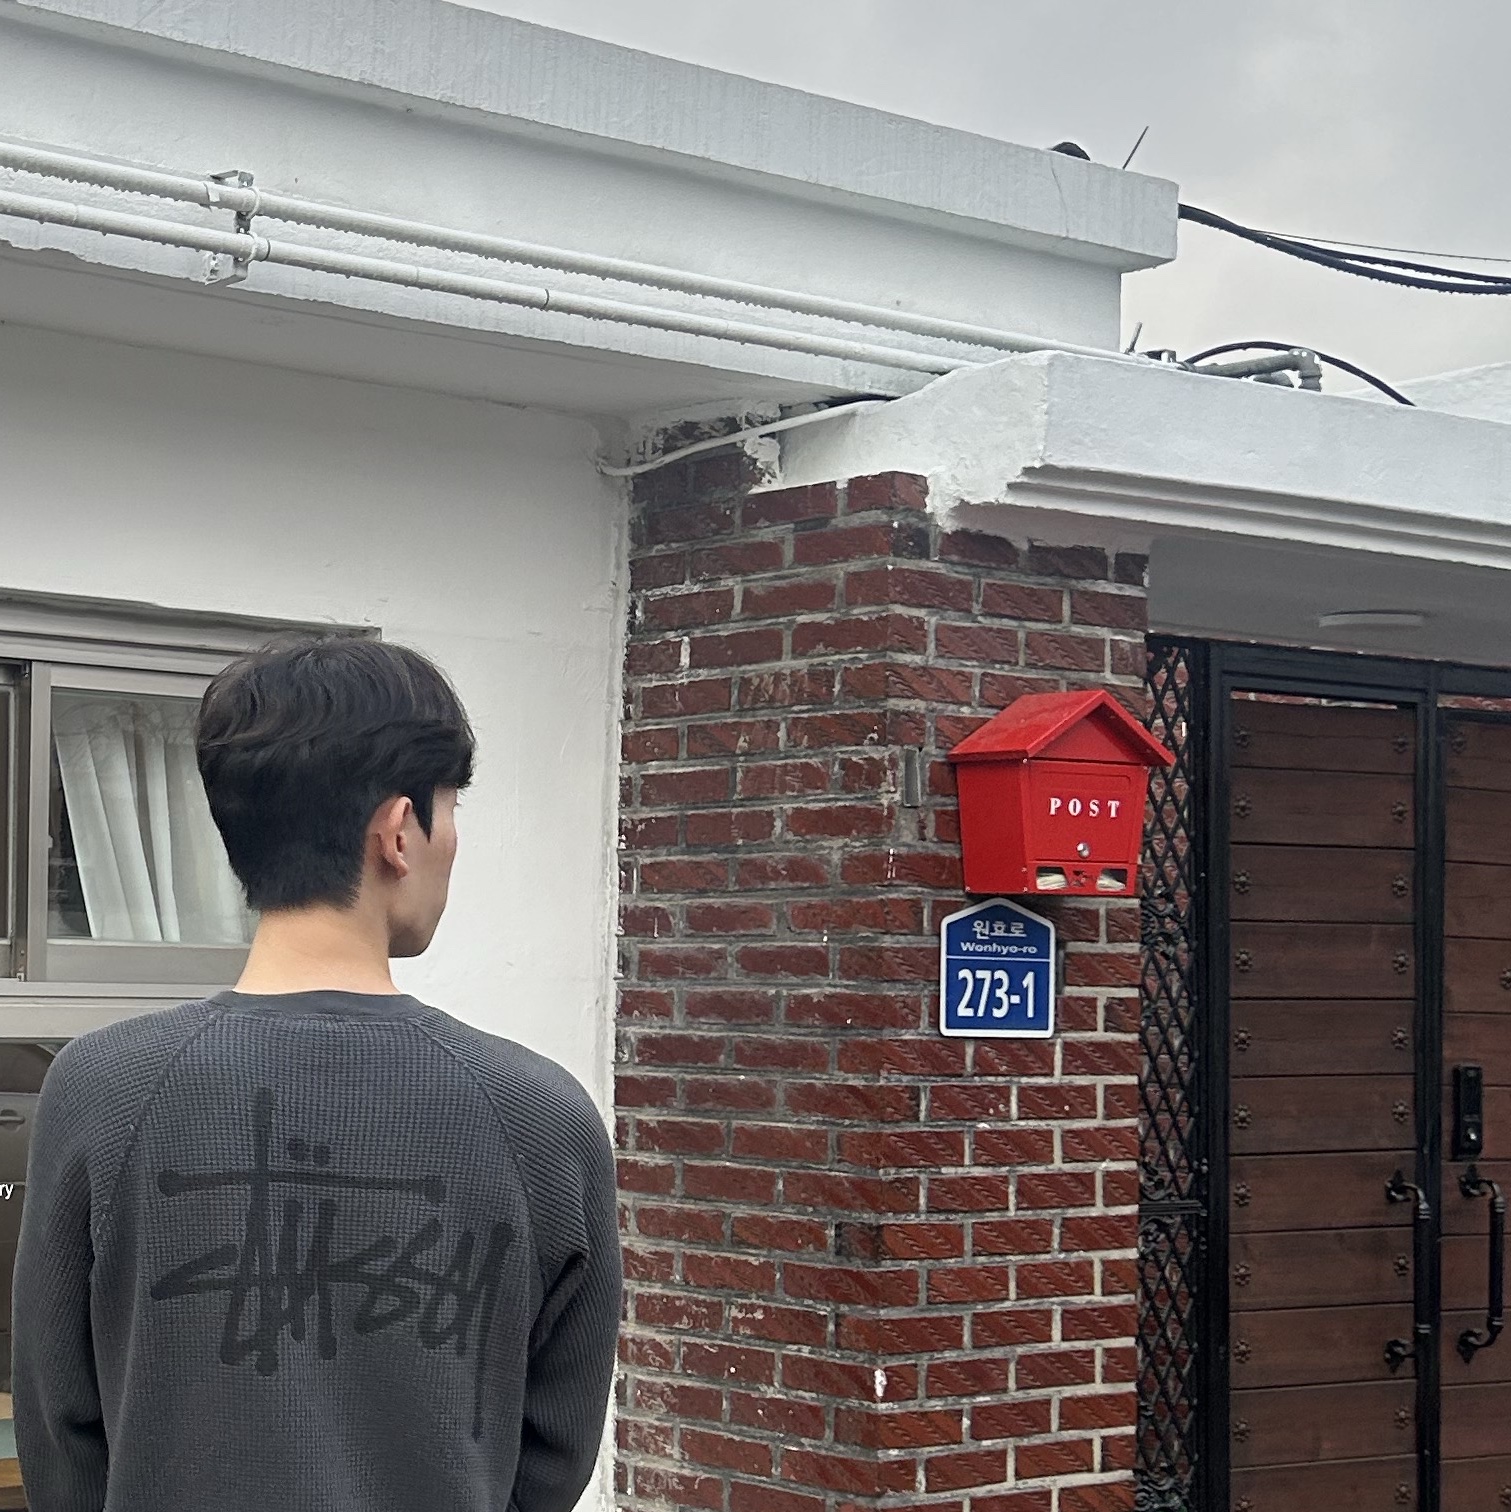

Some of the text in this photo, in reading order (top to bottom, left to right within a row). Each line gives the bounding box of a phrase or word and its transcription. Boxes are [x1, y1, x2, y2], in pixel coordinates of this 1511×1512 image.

[1048, 797, 1121, 819] POST
[972, 919, 1027, 940] 원효로
[960, 941, 1038, 956] Wonhyo-ro
[957, 968, 1036, 1019] 273-1
